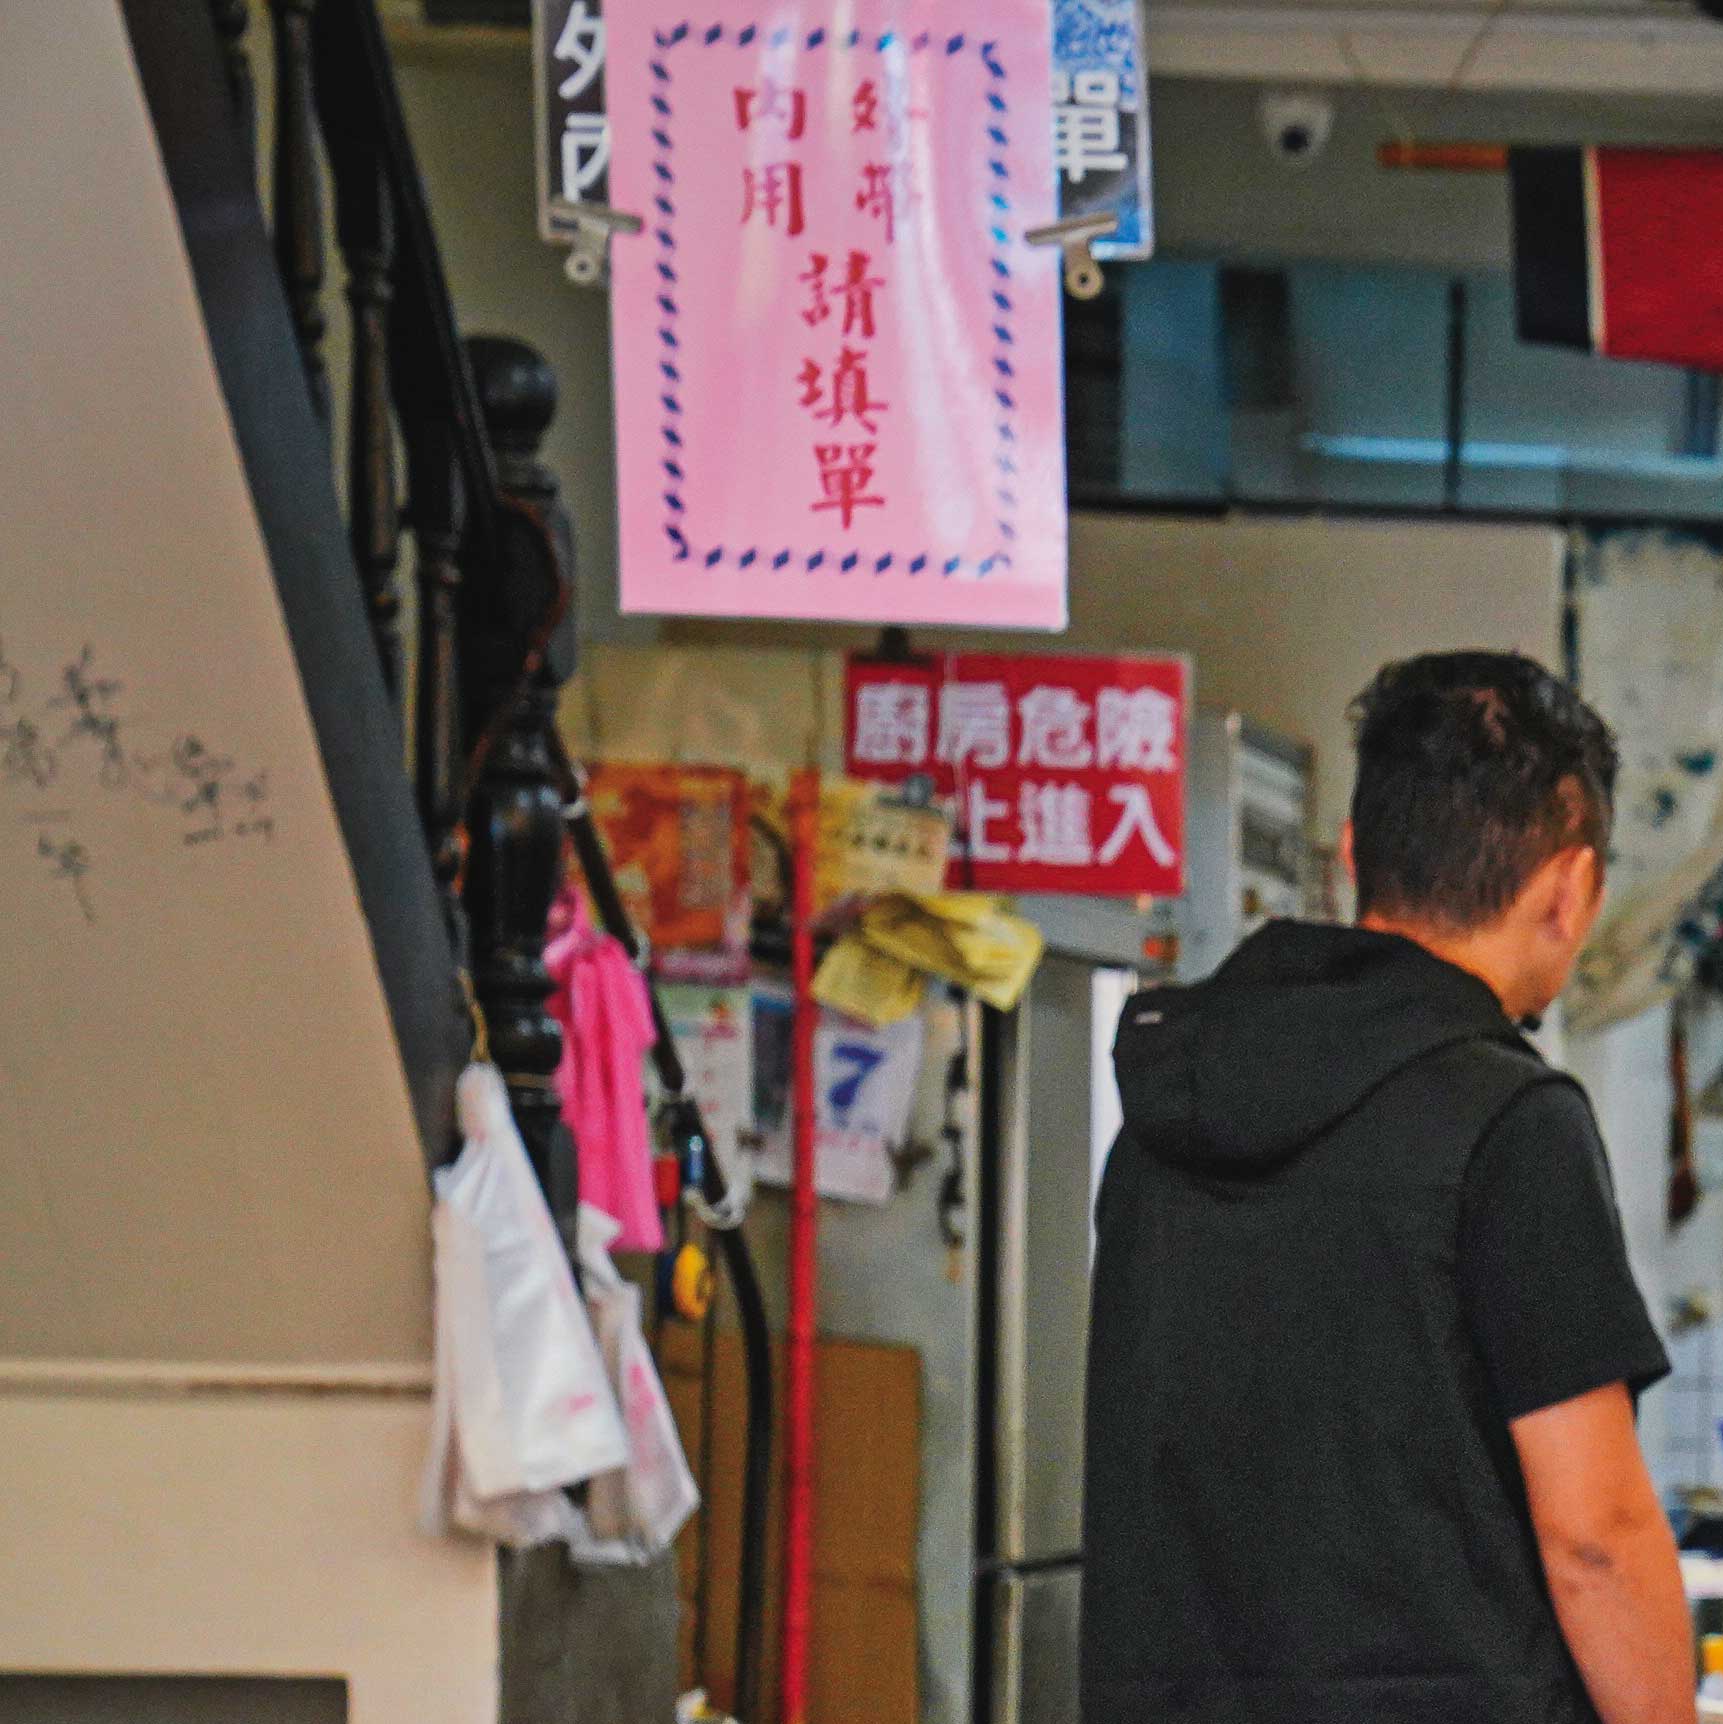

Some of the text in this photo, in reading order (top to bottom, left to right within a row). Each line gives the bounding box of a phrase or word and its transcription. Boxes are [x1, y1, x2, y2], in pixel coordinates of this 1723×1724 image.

[799, 250, 888, 530] 請填單
[854, 682, 1176, 771] 廚房危險
[949, 780, 1176, 867] 止進入
